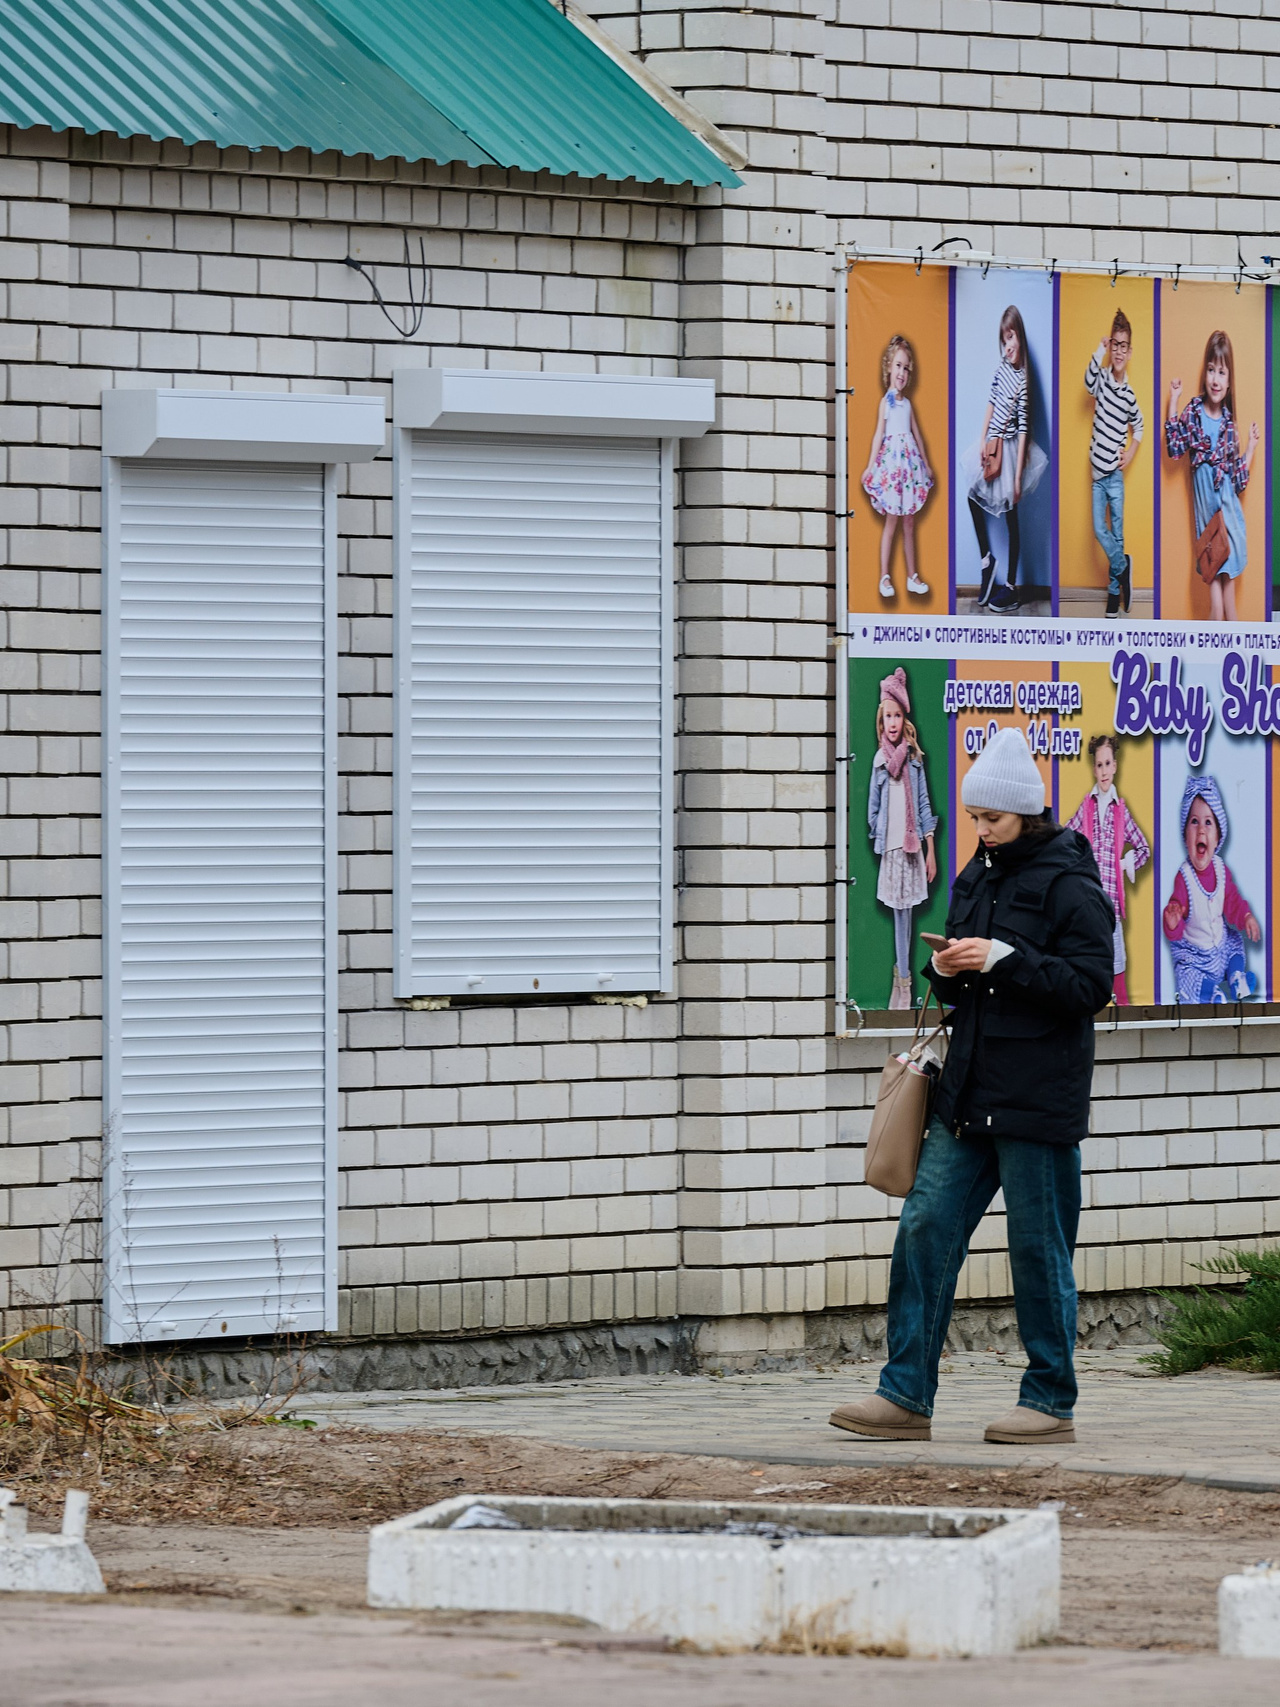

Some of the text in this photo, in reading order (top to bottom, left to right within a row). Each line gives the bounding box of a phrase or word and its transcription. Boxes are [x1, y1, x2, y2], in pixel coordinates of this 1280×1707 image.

[873, 626, 922, 644] ДЖИНСЫ
[935, 627, 1007, 644] СПОРТИВНЫЕ
[1010, 629, 1065, 645] КОСТЮМЫ
[1077, 630, 1115, 646] КУРТКИ
[1126, 631, 1187, 648] ТОЛСТОВКИ
[1198, 632, 1234, 648] БРЮКИ
[945, 681, 1081, 712] детская одежда
[1111, 648, 1213, 765] Baby
[965, 728, 985, 752] от
[1028, 722, 1048, 752] 14
[1052, 730, 1081, 752] лет
